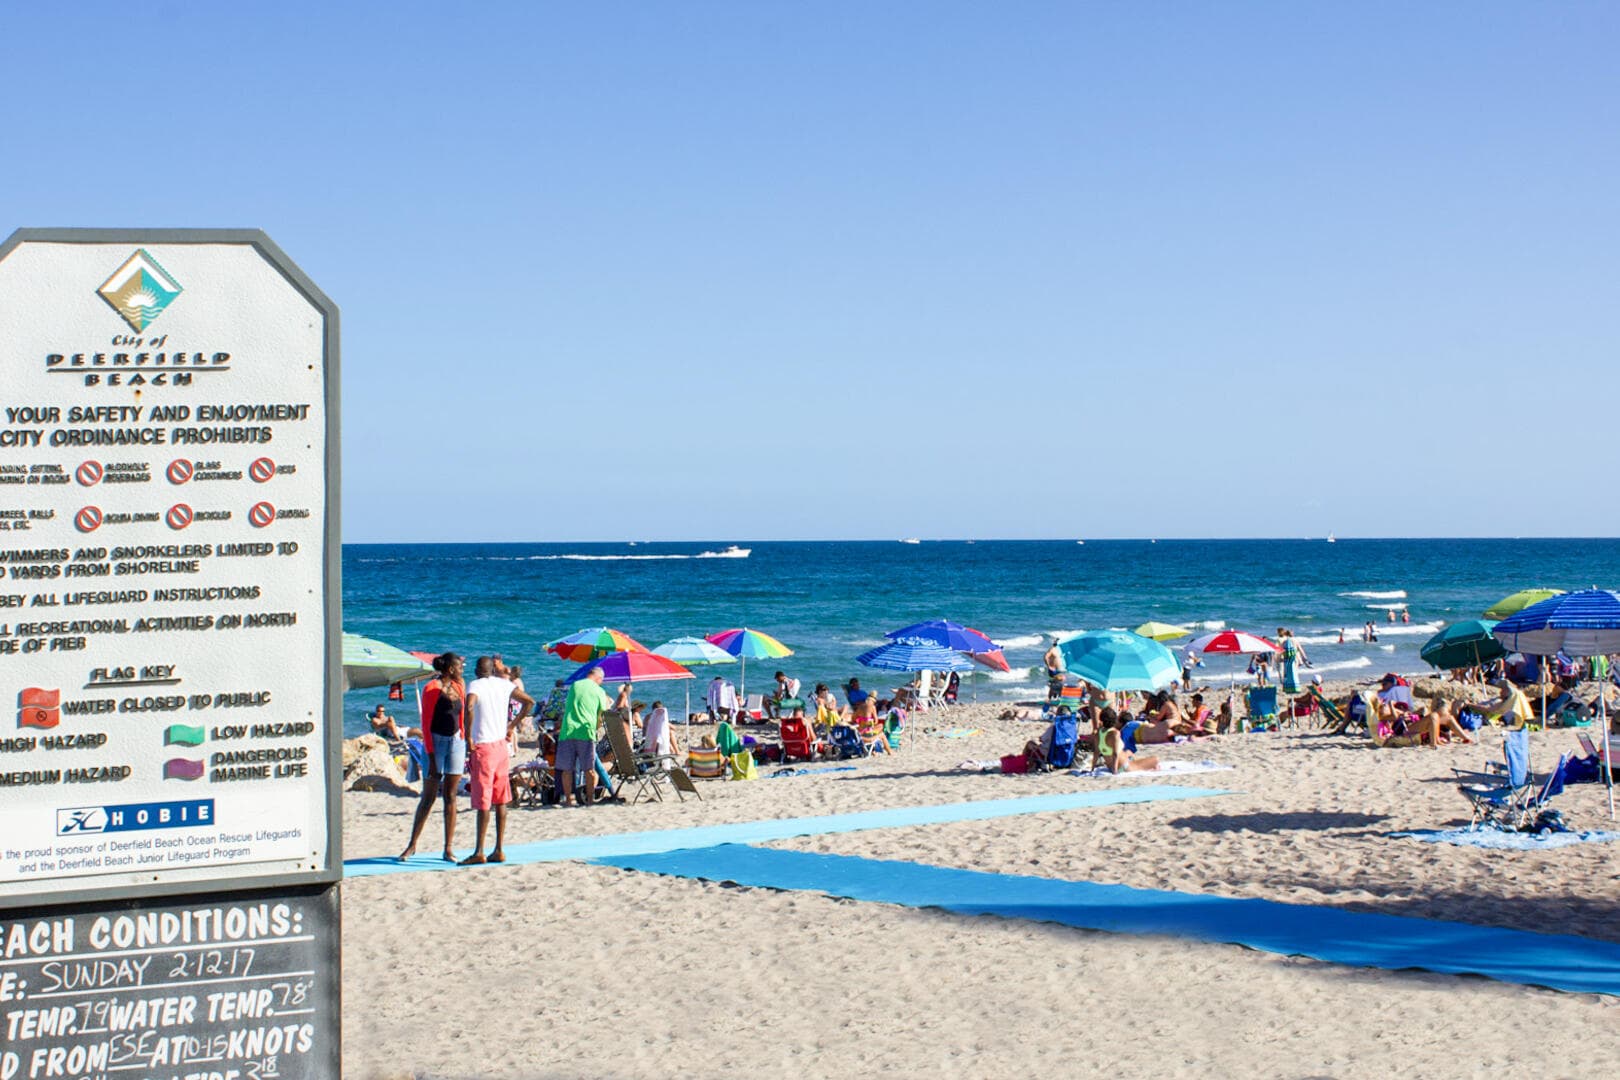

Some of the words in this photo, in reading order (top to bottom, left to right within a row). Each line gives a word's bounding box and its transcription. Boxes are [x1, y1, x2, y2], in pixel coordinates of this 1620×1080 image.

[112, 334, 143, 348] City
[150, 334, 168, 348] of
[46, 352, 230, 366] DEERFIELD
[85, 373, 192, 386] BEACH
[6, 406, 60, 423] YOUR
[68, 406, 143, 423] SAFETY
[149, 405, 190, 421] AND
[196, 404, 310, 421] ENJOYMENT
[0, 430, 44, 447] CITY
[51, 428, 166, 446] ORDINANCE
[172, 426, 272, 444] PROHIBITS
[73, 547, 107, 561] AND
[110, 544, 212, 559] SNORKELERS
[216, 542, 274, 557] LIMITED
[277, 541, 298, 555] TO
[10, 564, 61, 579] YARDS
[65, 562, 110, 577] FROM
[115, 560, 200, 575] SHORELINE
[31, 592, 59, 607] ALL
[64, 590, 148, 605] LIFEGUARD
[154, 586, 260, 601] INSTRUCTIONS
[15, 618, 130, 636] RECREATIONAL
[132, 615, 214, 632] ACTIVITIES
[216, 614, 241, 629] ON
[243, 612, 296, 628] NORTH
[22, 638, 47, 653] OF
[50, 636, 86, 652] PIER
[90, 667, 135, 681] FLAG
[140, 665, 176, 679] KEY
[62, 699, 116, 714] WATER
[119, 696, 185, 712] CLOSED
[189, 694, 212, 709] TO
[214, 691, 271, 708] PUBLIC
[211, 725, 248, 740] LOW
[251, 722, 314, 739] HAZARD
[0, 737, 36, 752] HIGH
[40, 733, 107, 750] HAZARD
[211, 747, 308, 766] DANGEROUS
[0, 770, 61, 786] MEDIUM
[63, 766, 131, 783] HAZARD
[210, 765, 271, 783] MARINE
[274, 763, 308, 778] LIFE
[112, 805, 209, 826] HOBIE
[6, 849, 21, 860] the
[24, 847, 52, 859] proud
[55, 845, 93, 857] sponsor
[97, 842, 107, 852] of
[110, 839, 152, 851] Deerfield
[155, 836, 184, 848] Beach
[186, 835, 216, 846] Ocean
[219, 832, 253, 843] Rescue
[256, 828, 302, 842] Lifeguards
[19, 863, 37, 873] and
[40, 861, 55, 872] the
[59, 857, 101, 870] Deerfield
[104, 854, 133, 867] Beach
[137, 852, 164, 864] Junior
[168, 850, 210, 862] Lifeguard
[213, 847, 251, 859] Program
[89, 903, 303, 949] CONDITIONS:
[41, 955, 152, 992] SUNDAY
[7, 1006, 77, 1041] TEMP.
[109, 995, 197, 1032] WATER
[207, 988, 274, 1022] TEMP.
[30, 1042, 109, 1079] FROM
[150, 1035, 187, 1069] AT
[227, 1023, 314, 1059] KNOTS
